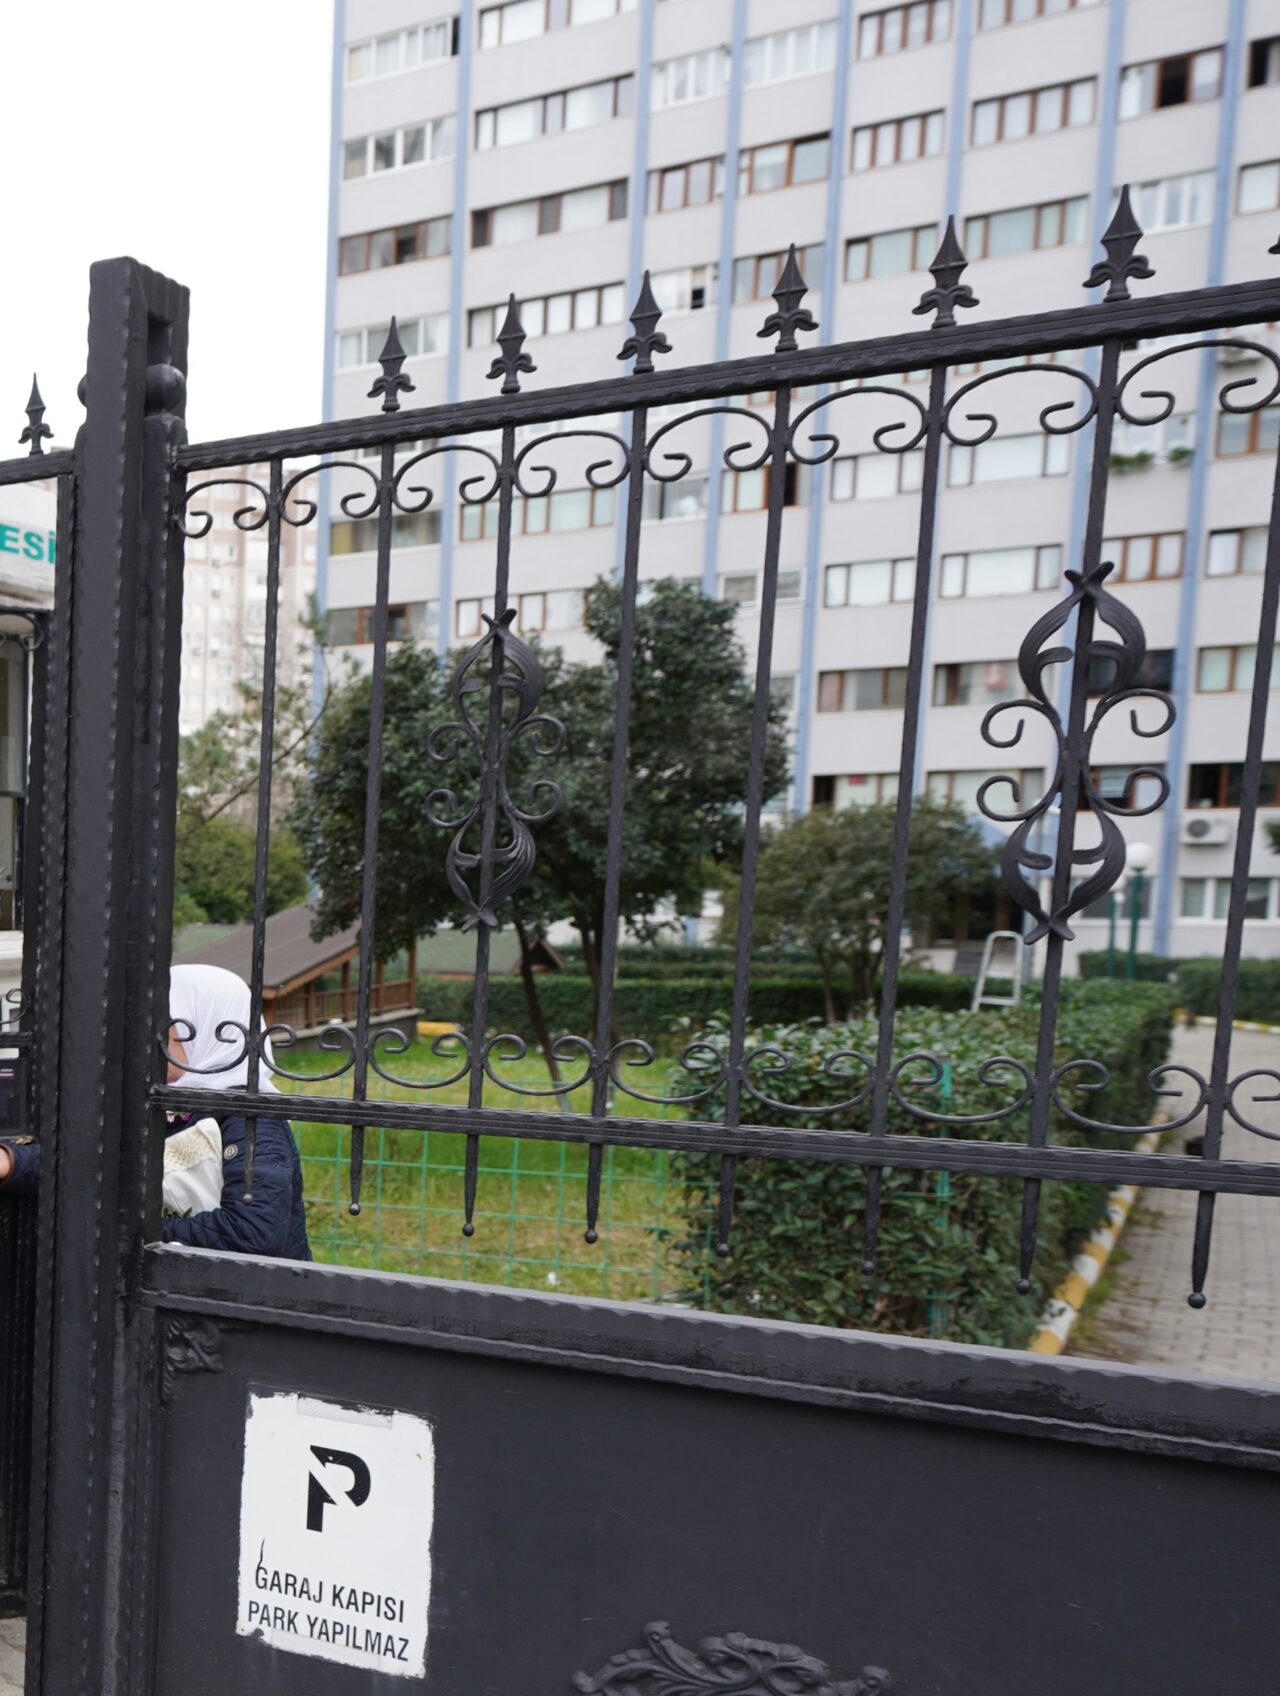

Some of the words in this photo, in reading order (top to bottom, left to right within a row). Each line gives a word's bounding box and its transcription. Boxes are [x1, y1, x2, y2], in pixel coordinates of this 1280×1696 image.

[254, 1564, 323, 1604] GARAJ
[331, 1583, 405, 1623] KAPISI
[247, 1600, 299, 1635] PARK
[306, 1613, 410, 1663] YAPILMAZ
